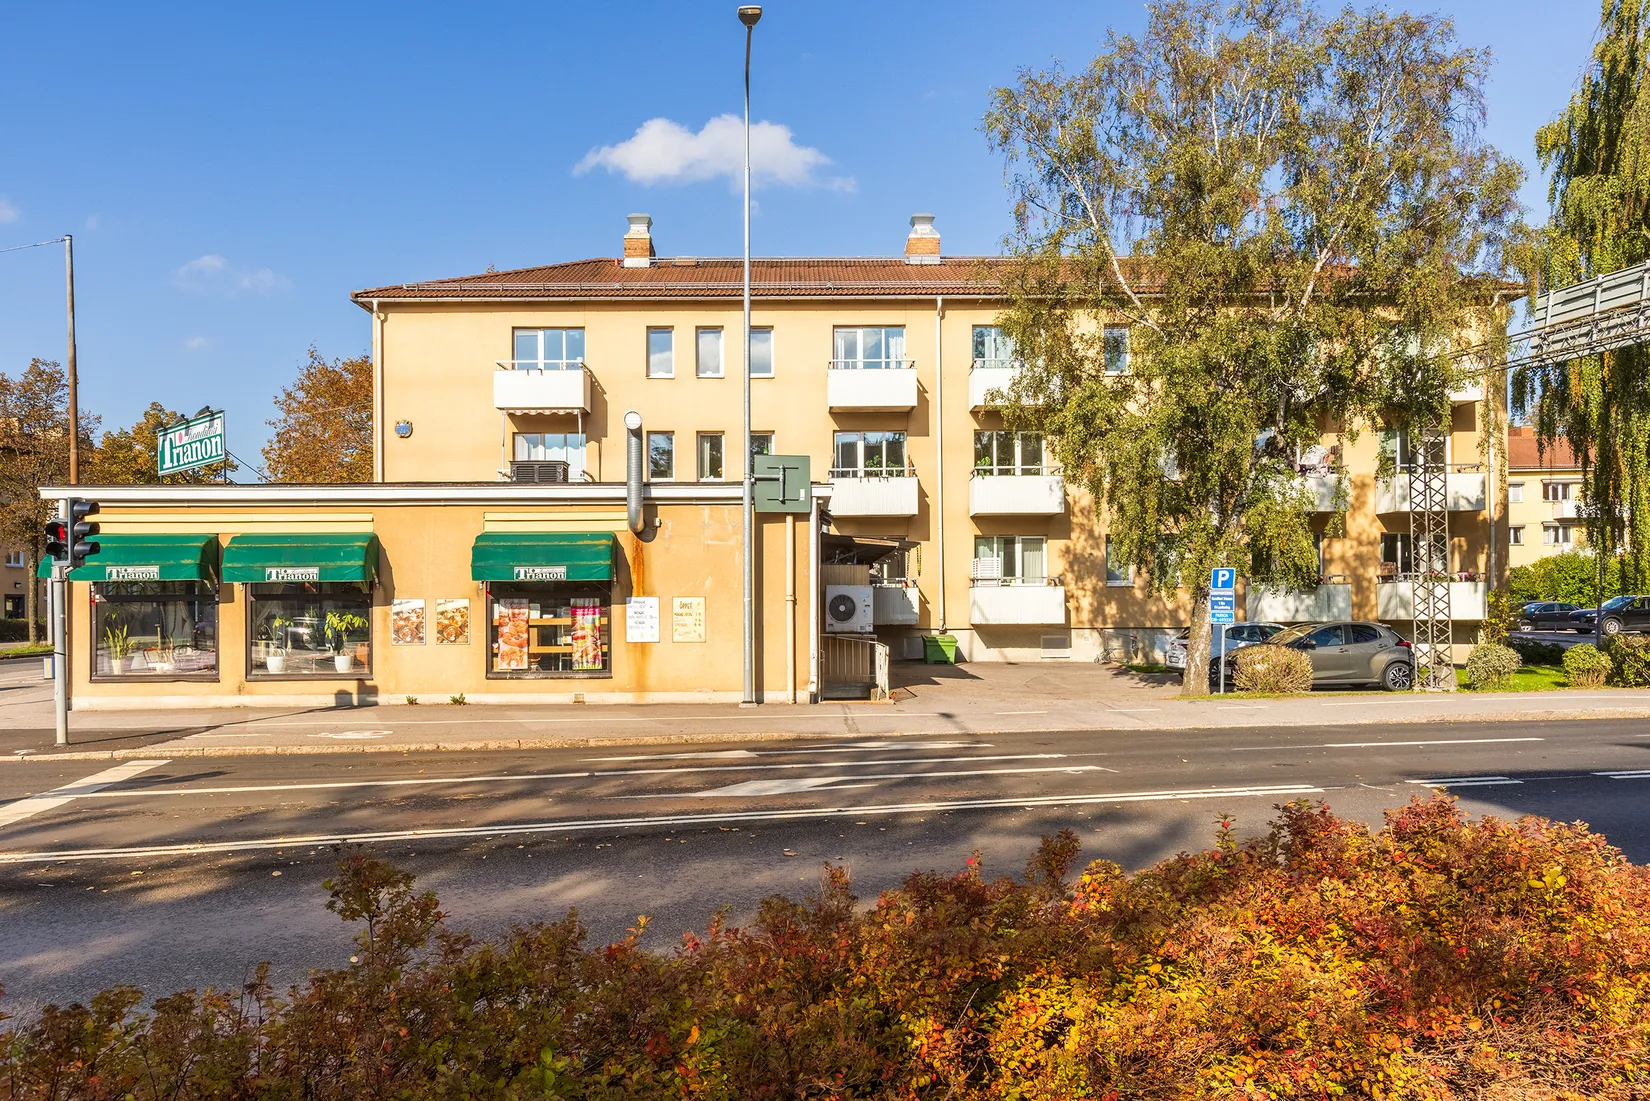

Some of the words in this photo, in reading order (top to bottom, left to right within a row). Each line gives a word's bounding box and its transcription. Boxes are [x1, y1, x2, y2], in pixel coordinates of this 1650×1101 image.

[160, 432, 223, 470] Trianon
[107, 568, 158, 580] Trianon
[267, 569, 317, 581] Trianon
[515, 568, 566, 580] Trianon
[1217, 570, 1230, 588] P
